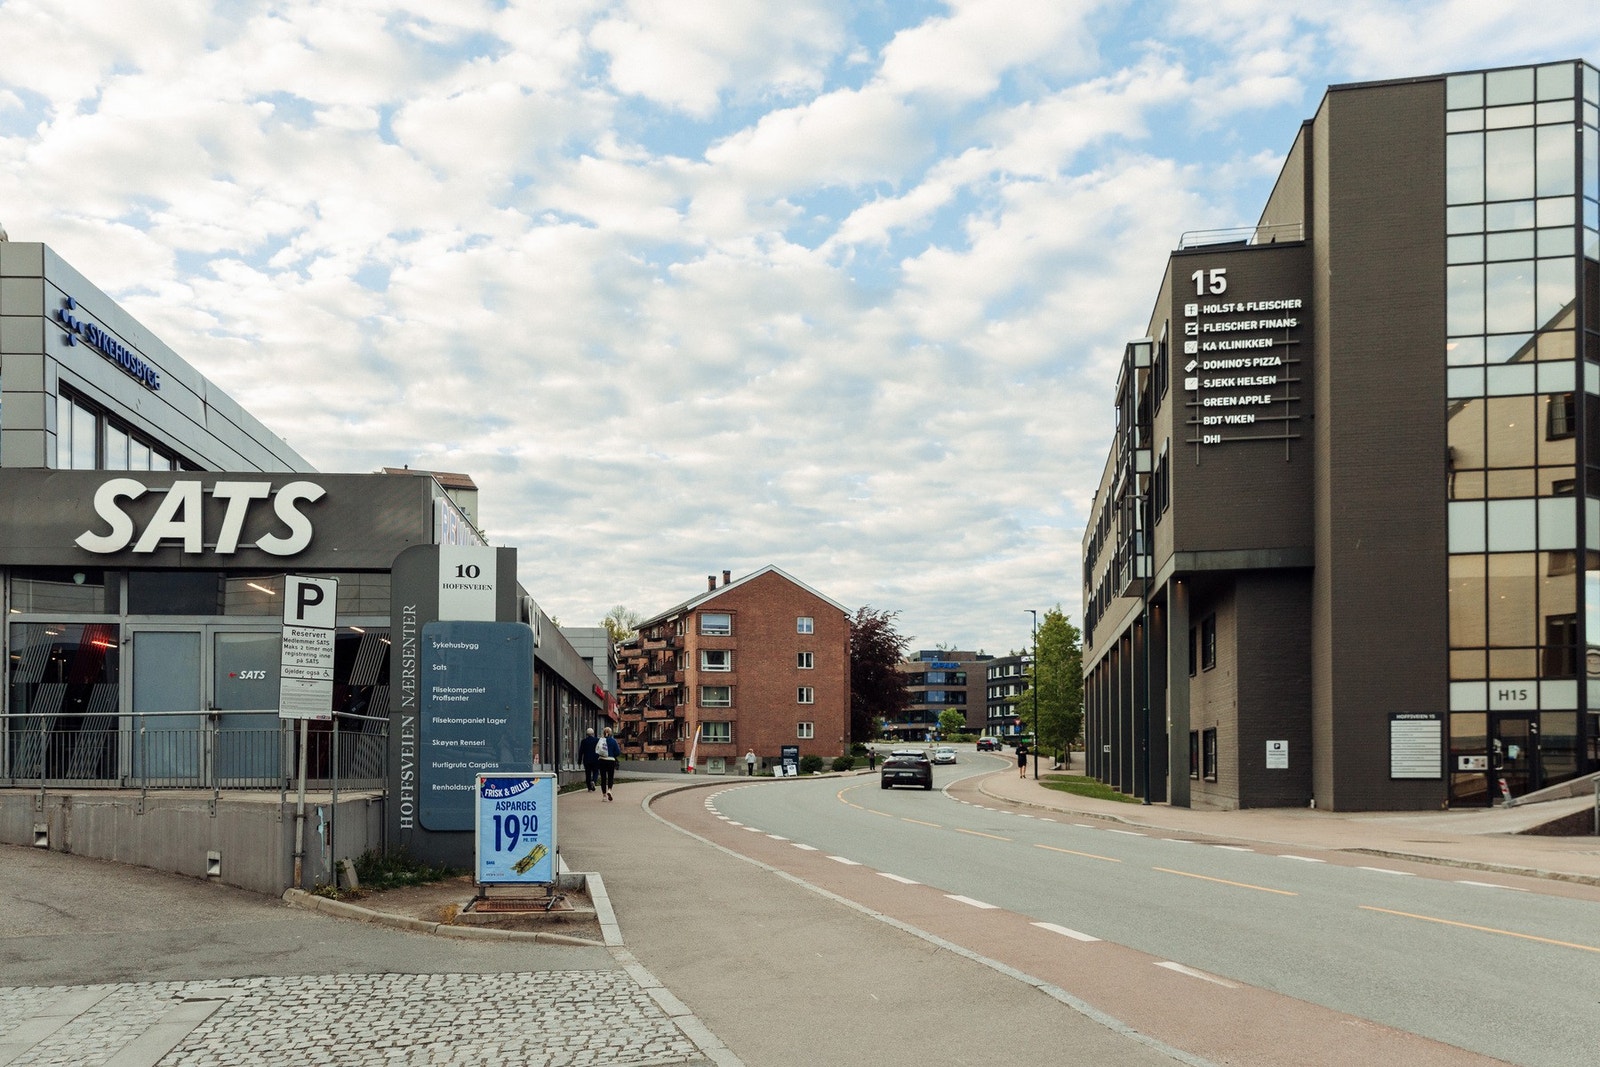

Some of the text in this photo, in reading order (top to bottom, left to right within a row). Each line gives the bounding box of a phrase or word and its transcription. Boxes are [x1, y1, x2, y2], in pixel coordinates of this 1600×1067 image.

[1191, 268, 1227, 296] 15
[1203, 299, 1302, 314] HOLST & FLEISCHER
[1203, 318, 1297, 333] FLEISCHER FINANS
[1203, 338, 1273, 351] KA KLINIKKEN
[87, 323, 161, 391] SYKEHUSBYGG
[1203, 357, 1281, 370] DOMINO'S PIZZA
[1203, 375, 1277, 388] SJEKK HELSEN
[1203, 395, 1271, 407] GREEN APPLE
[1203, 414, 1255, 425] BDT VIKEN
[1203, 435, 1221, 444] DHI
[74, 478, 327, 556] SATS
[455, 564, 481, 579] 10
[442, 583, 493, 591] HOFFSVEIEN
[297, 582, 324, 620] P
[291, 629, 327, 639] Reservert
[283, 637, 315, 645] Medlemmer
[432, 641, 480, 650] Sykehusbygg
[285, 651, 317, 659] registrering
[432, 663, 447, 671] Sats
[238, 670, 266, 680] SATS
[432, 686, 486, 694] Flisekompaniet
[1498, 689, 1528, 701] H15
[400, 604, 417, 830] HOFFSVEIEN NÆRSENTER
[432, 717, 507, 725] Flisekompaniet Lager
[432, 739, 459, 747] Skøyen
[432, 761, 467, 770] Hurtigruta
[432, 783, 476, 792] Renholdssys
[484, 780, 530, 797] FRISK & BILLIG
[495, 801, 537, 811] ASPARGES
[493, 814, 538, 852] 19 90
